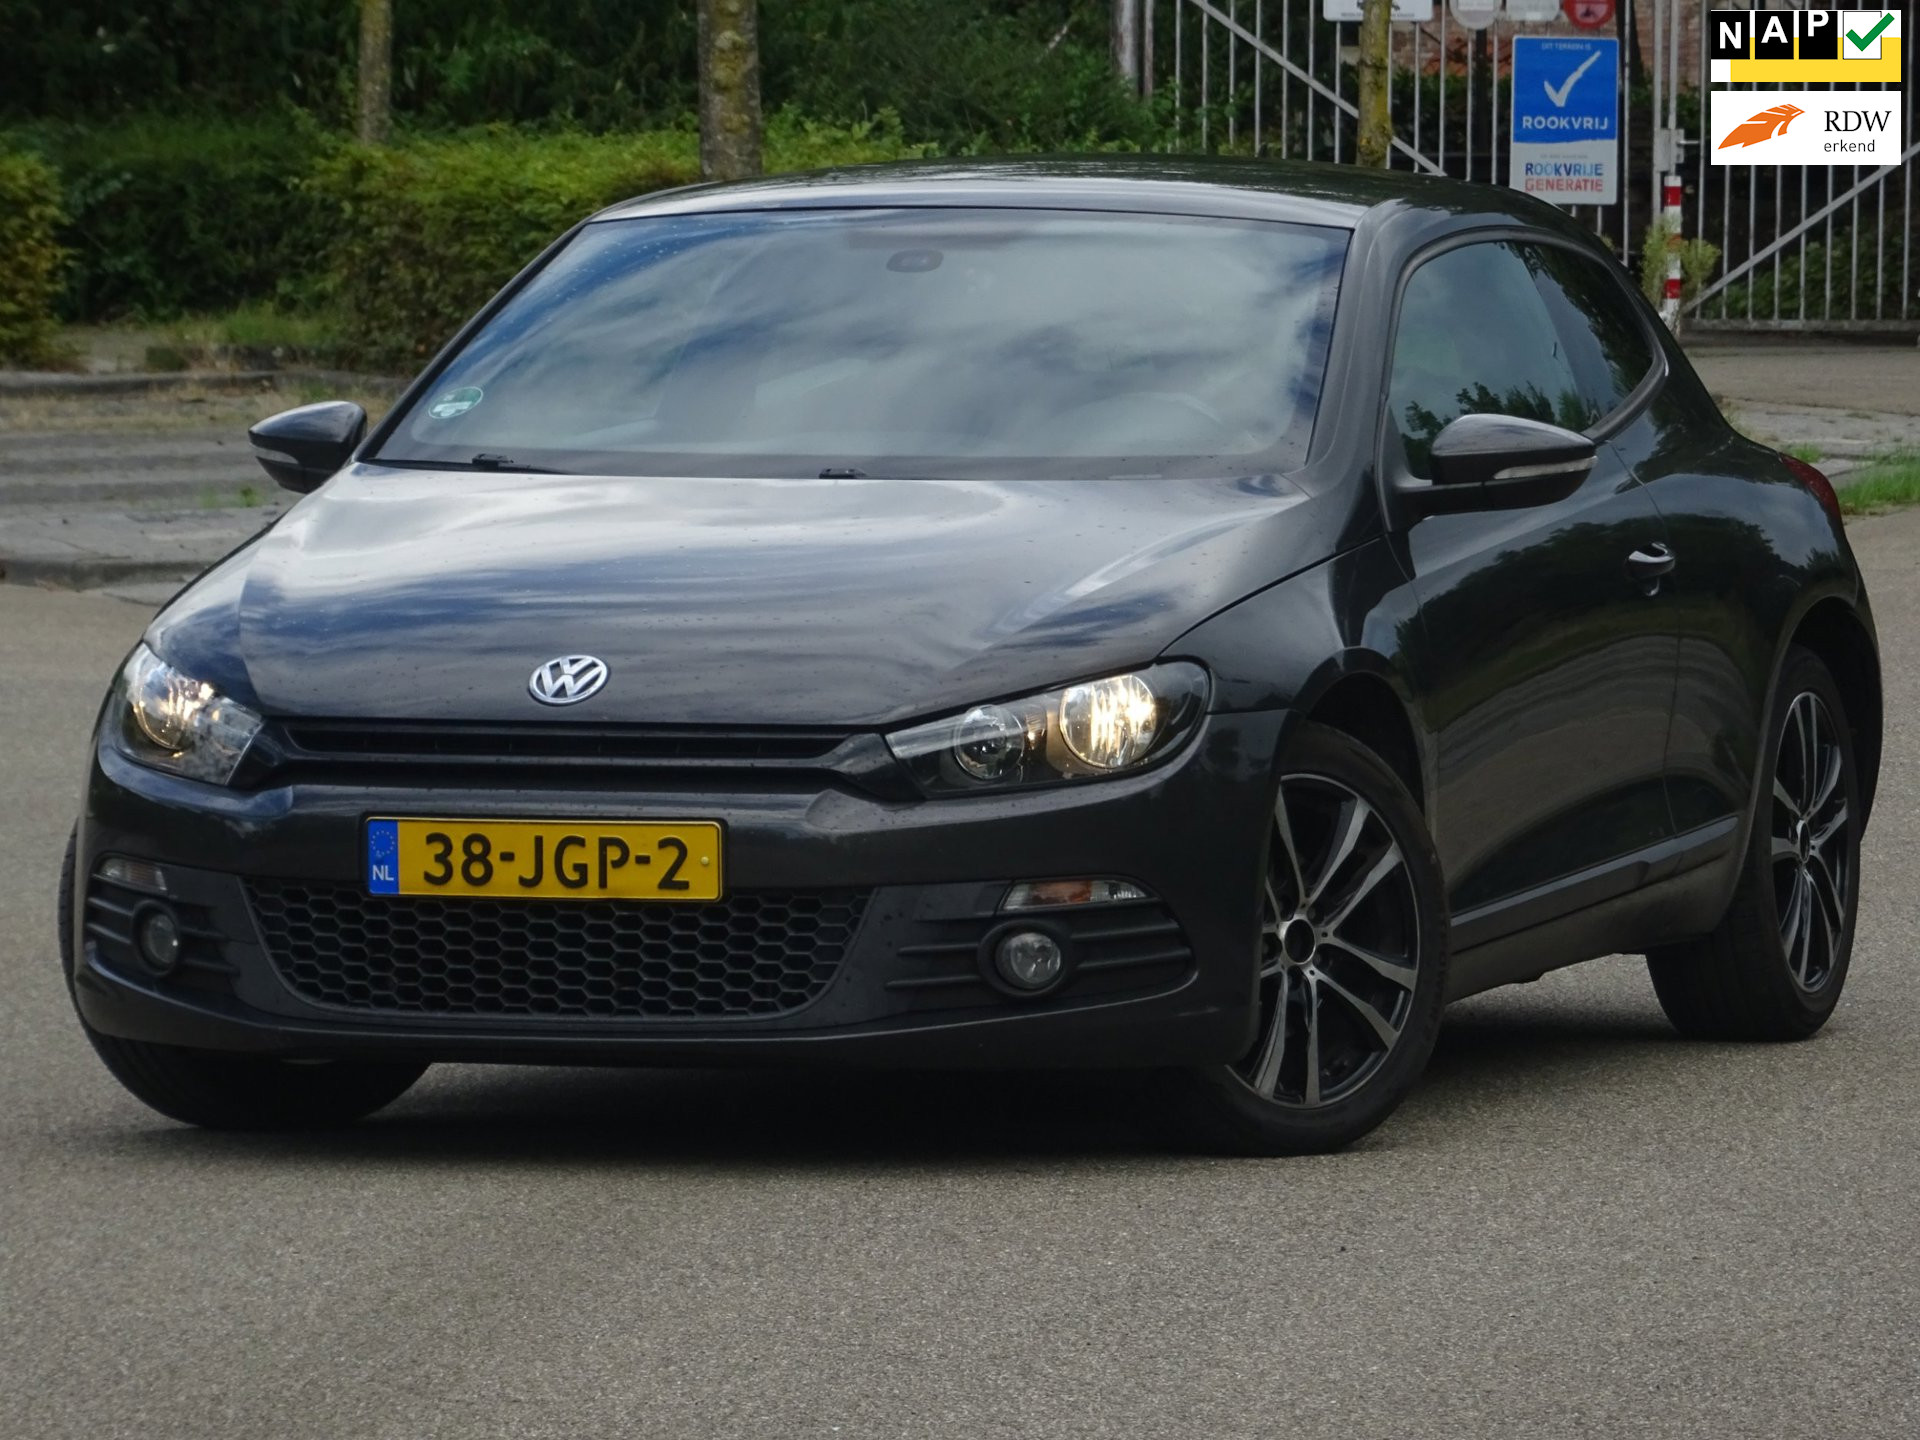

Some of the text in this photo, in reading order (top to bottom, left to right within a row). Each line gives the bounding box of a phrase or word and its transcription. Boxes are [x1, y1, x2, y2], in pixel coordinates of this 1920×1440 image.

[1522, 116, 1609, 130] ROOKVRIJ
[1525, 162, 1604, 177] ROOKVRIJE
[1525, 178, 1603, 193] GENERATIE
[423, 832, 690, 891] 38-JGP-2
[372, 864, 395, 881] NL
